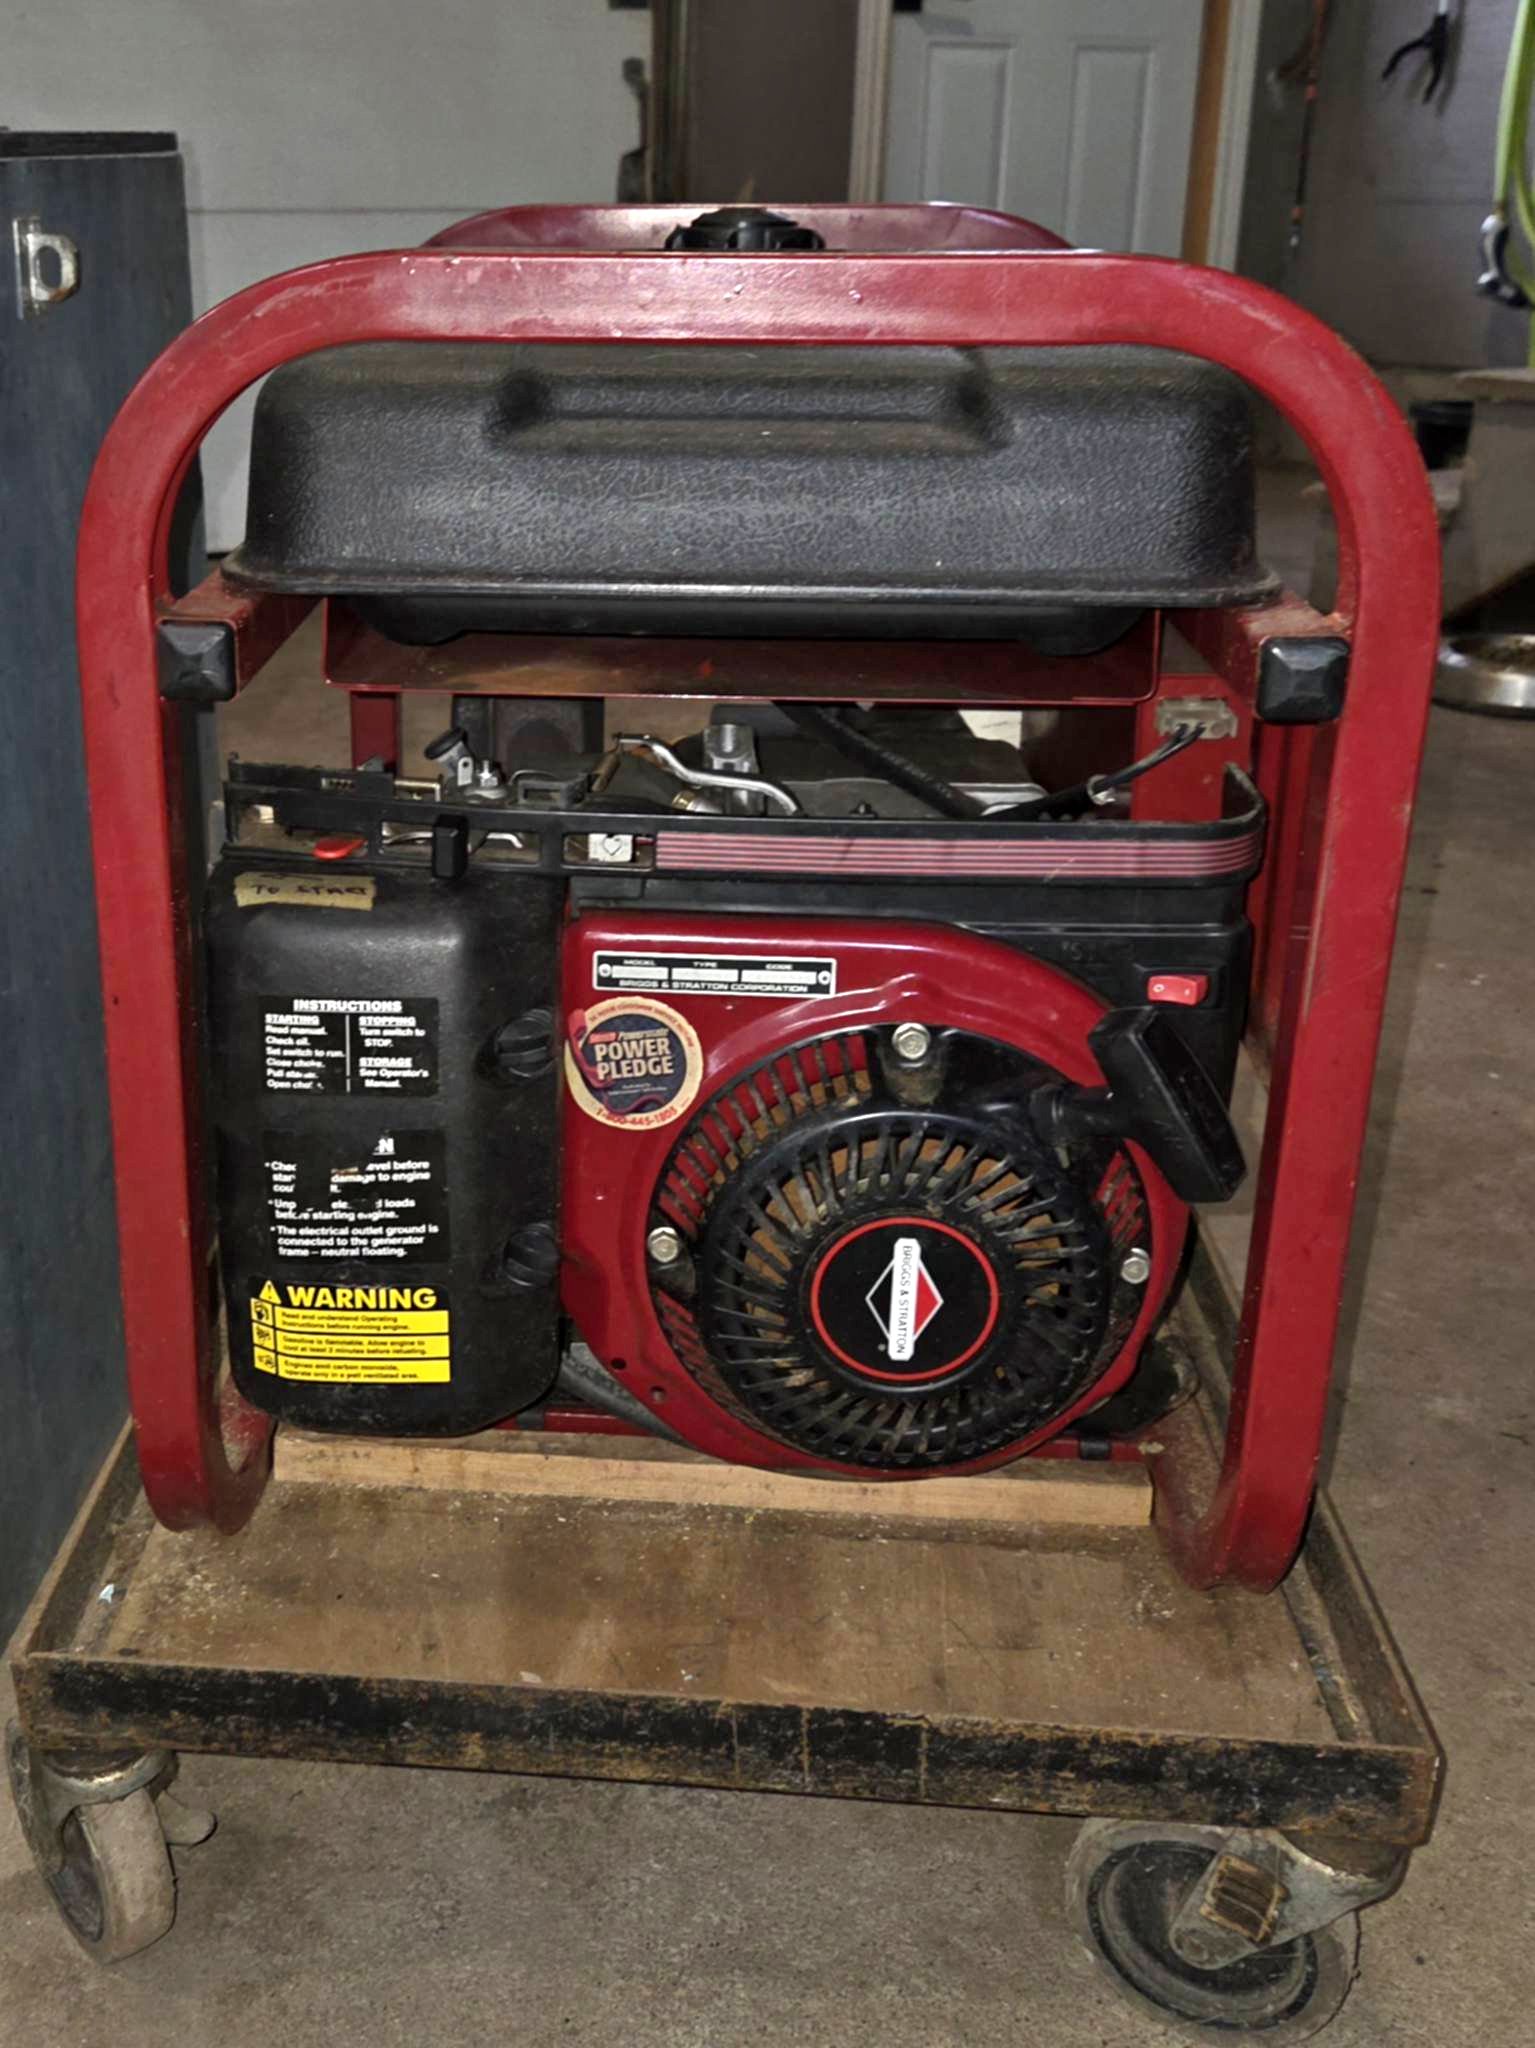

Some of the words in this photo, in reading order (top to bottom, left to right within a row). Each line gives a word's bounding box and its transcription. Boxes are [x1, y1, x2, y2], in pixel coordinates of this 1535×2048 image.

[619, 980, 658, 988] BRIGGS
[672, 981, 728, 990] STRATTON
[731, 983, 808, 993] CORPORATION
[293, 999, 403, 1013] INSTRUCTIONS
[265, 1012, 320, 1026] STARTING
[359, 1016, 417, 1027] STOPPING
[265, 1024, 289, 1034] Read
[290, 1026, 328, 1035] manual.
[360, 1027, 381, 1036] Turn
[382, 1028, 414, 1037] switch
[415, 1028, 426, 1037] to
[265, 1035, 294, 1045] Check
[364, 1038, 394, 1048] STOP.
[266, 1046, 281, 1055] Set
[282, 1048, 313, 1057] switch
[314, 1048, 325, 1057] to
[594, 1037, 672, 1062] POWER
[266, 1057, 292, 1067] Close
[359, 1057, 412, 1068] STORAGE
[597, 1055, 674, 1081] PLEDGE
[266, 1068, 284, 1077] Pull
[359, 1067, 378, 1077] See
[379, 1068, 429, 1079] Operator's
[267, 1079, 291, 1090] Open
[364, 1079, 402, 1088] Manual.
[392, 1160, 430, 1171] before
[378, 1172, 390, 1182] to
[391, 1171, 431, 1183] engine
[384, 1198, 415, 1208] loads
[312, 1210, 355, 1222] starting
[277, 1225, 297, 1236] The
[298, 1226, 349, 1236] electrical
[351, 1226, 384, 1236] outlet
[385, 1224, 426, 1237] ground
[428, 1223, 440, 1234] is
[277, 1236, 335, 1246] connected
[336, 1237, 349, 1246] to
[350, 1237, 369, 1246] the
[370, 1236, 425, 1248] generator
[278, 1246, 310, 1256] frame
[320, 1247, 360, 1257] neutral
[362, 1246, 407, 1258] floating.
[899, 1245, 913, 1287] BRIGGS
[287, 1286, 437, 1309] WARNING
[896, 1299, 910, 1354] STRATTON
